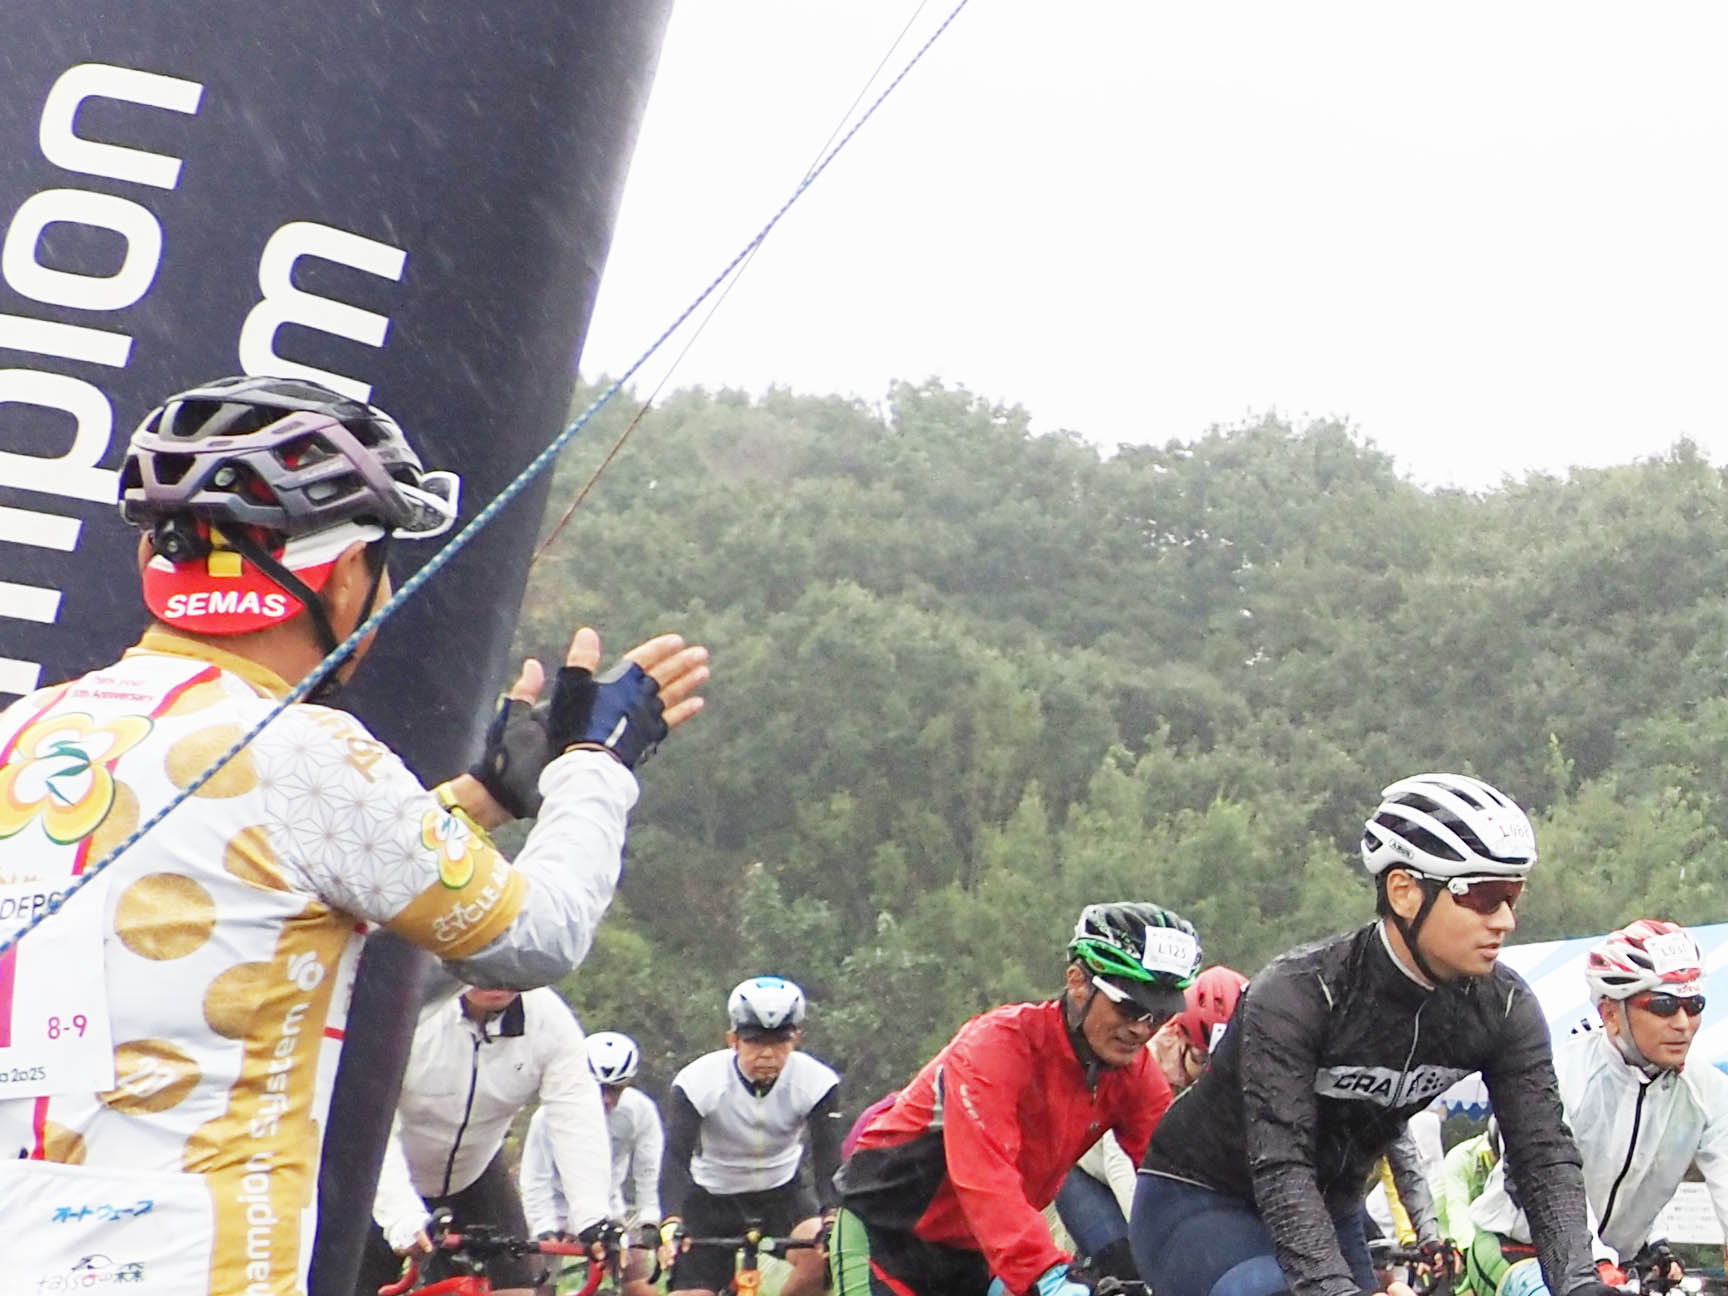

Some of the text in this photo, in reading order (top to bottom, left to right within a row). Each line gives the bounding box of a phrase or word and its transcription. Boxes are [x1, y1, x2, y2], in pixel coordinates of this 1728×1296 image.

[164, 590, 287, 618] SEMAS
[47, 1015, 88, 1040] 8-9
[250, 1001, 309, 1138] System
